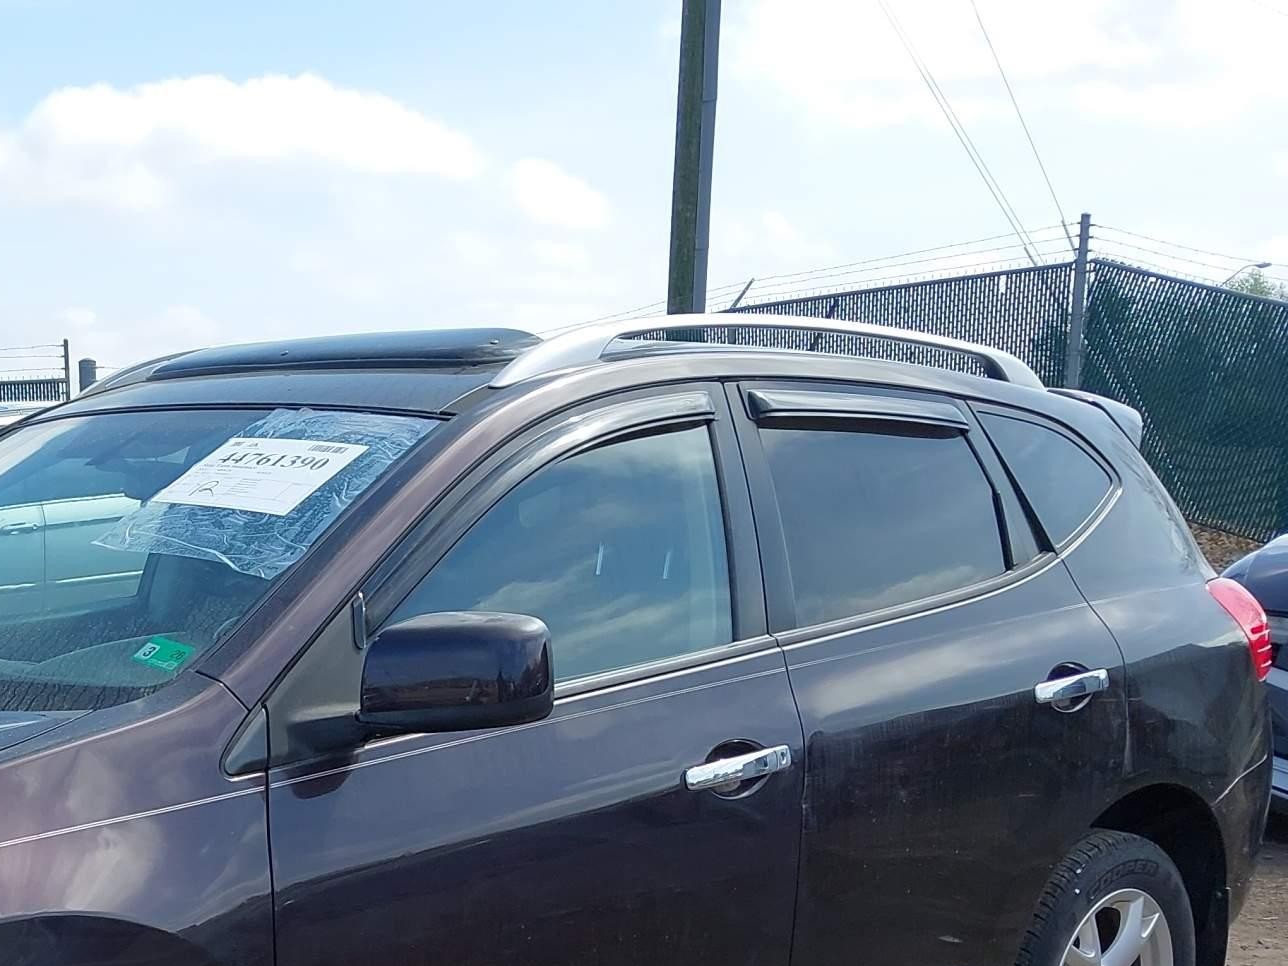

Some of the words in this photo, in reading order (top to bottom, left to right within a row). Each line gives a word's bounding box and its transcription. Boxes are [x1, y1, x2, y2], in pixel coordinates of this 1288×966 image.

[218, 451, 330, 471] 44761390
[142, 646, 156, 657] 3
[1088, 859, 1160, 902] COOPER
